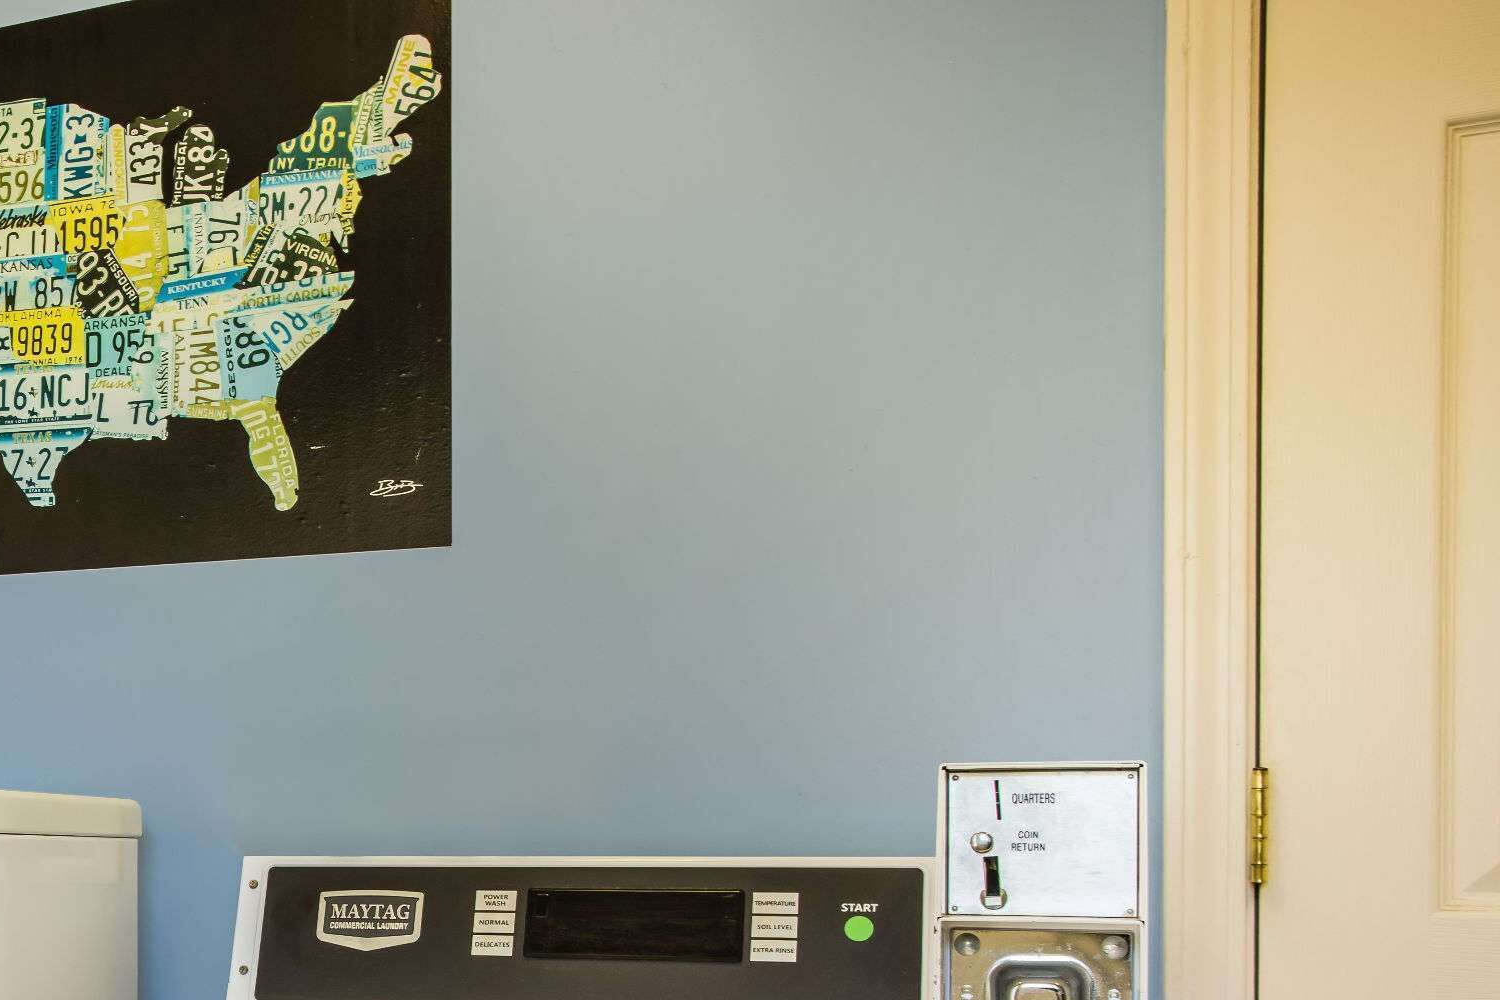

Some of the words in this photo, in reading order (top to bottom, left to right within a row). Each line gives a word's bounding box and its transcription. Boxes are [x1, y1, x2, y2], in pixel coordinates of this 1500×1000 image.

[385, 40, 415, 105] MAINE
[63, 145, 96, 200] KWG
[113, 127, 124, 201] WISCONSIN
[214, 168, 226, 203] REAT
[266, 169, 340, 186] PENNSYLVANIA
[52, 203, 94, 217] IOWA
[101, 199, 115, 209] 72
[194, 212, 204, 265] INDIANA
[0, 257, 54, 274] KANSAS
[103, 252, 138, 308] MISSOURI
[167, 276, 228, 295] KENTUCKY
[223, 317, 238, 399] GEORGIA
[173, 333, 187, 403] Alabama
[156, 350, 170, 410] MISSISSIPPI
[11, 431, 53, 444] TEXAS
[272, 413, 296, 489] FLORIDA
[1011, 792, 1056, 804] QUARTERS
[1017, 830, 1039, 839] COIN
[1011, 842, 1046, 852] RETURN
[330, 903, 410, 920] MAYTAG
[840, 903, 879, 913] START
[329, 921, 376, 930] COMMERCIAL
[376, 922, 409, 930] LAUNDRY
